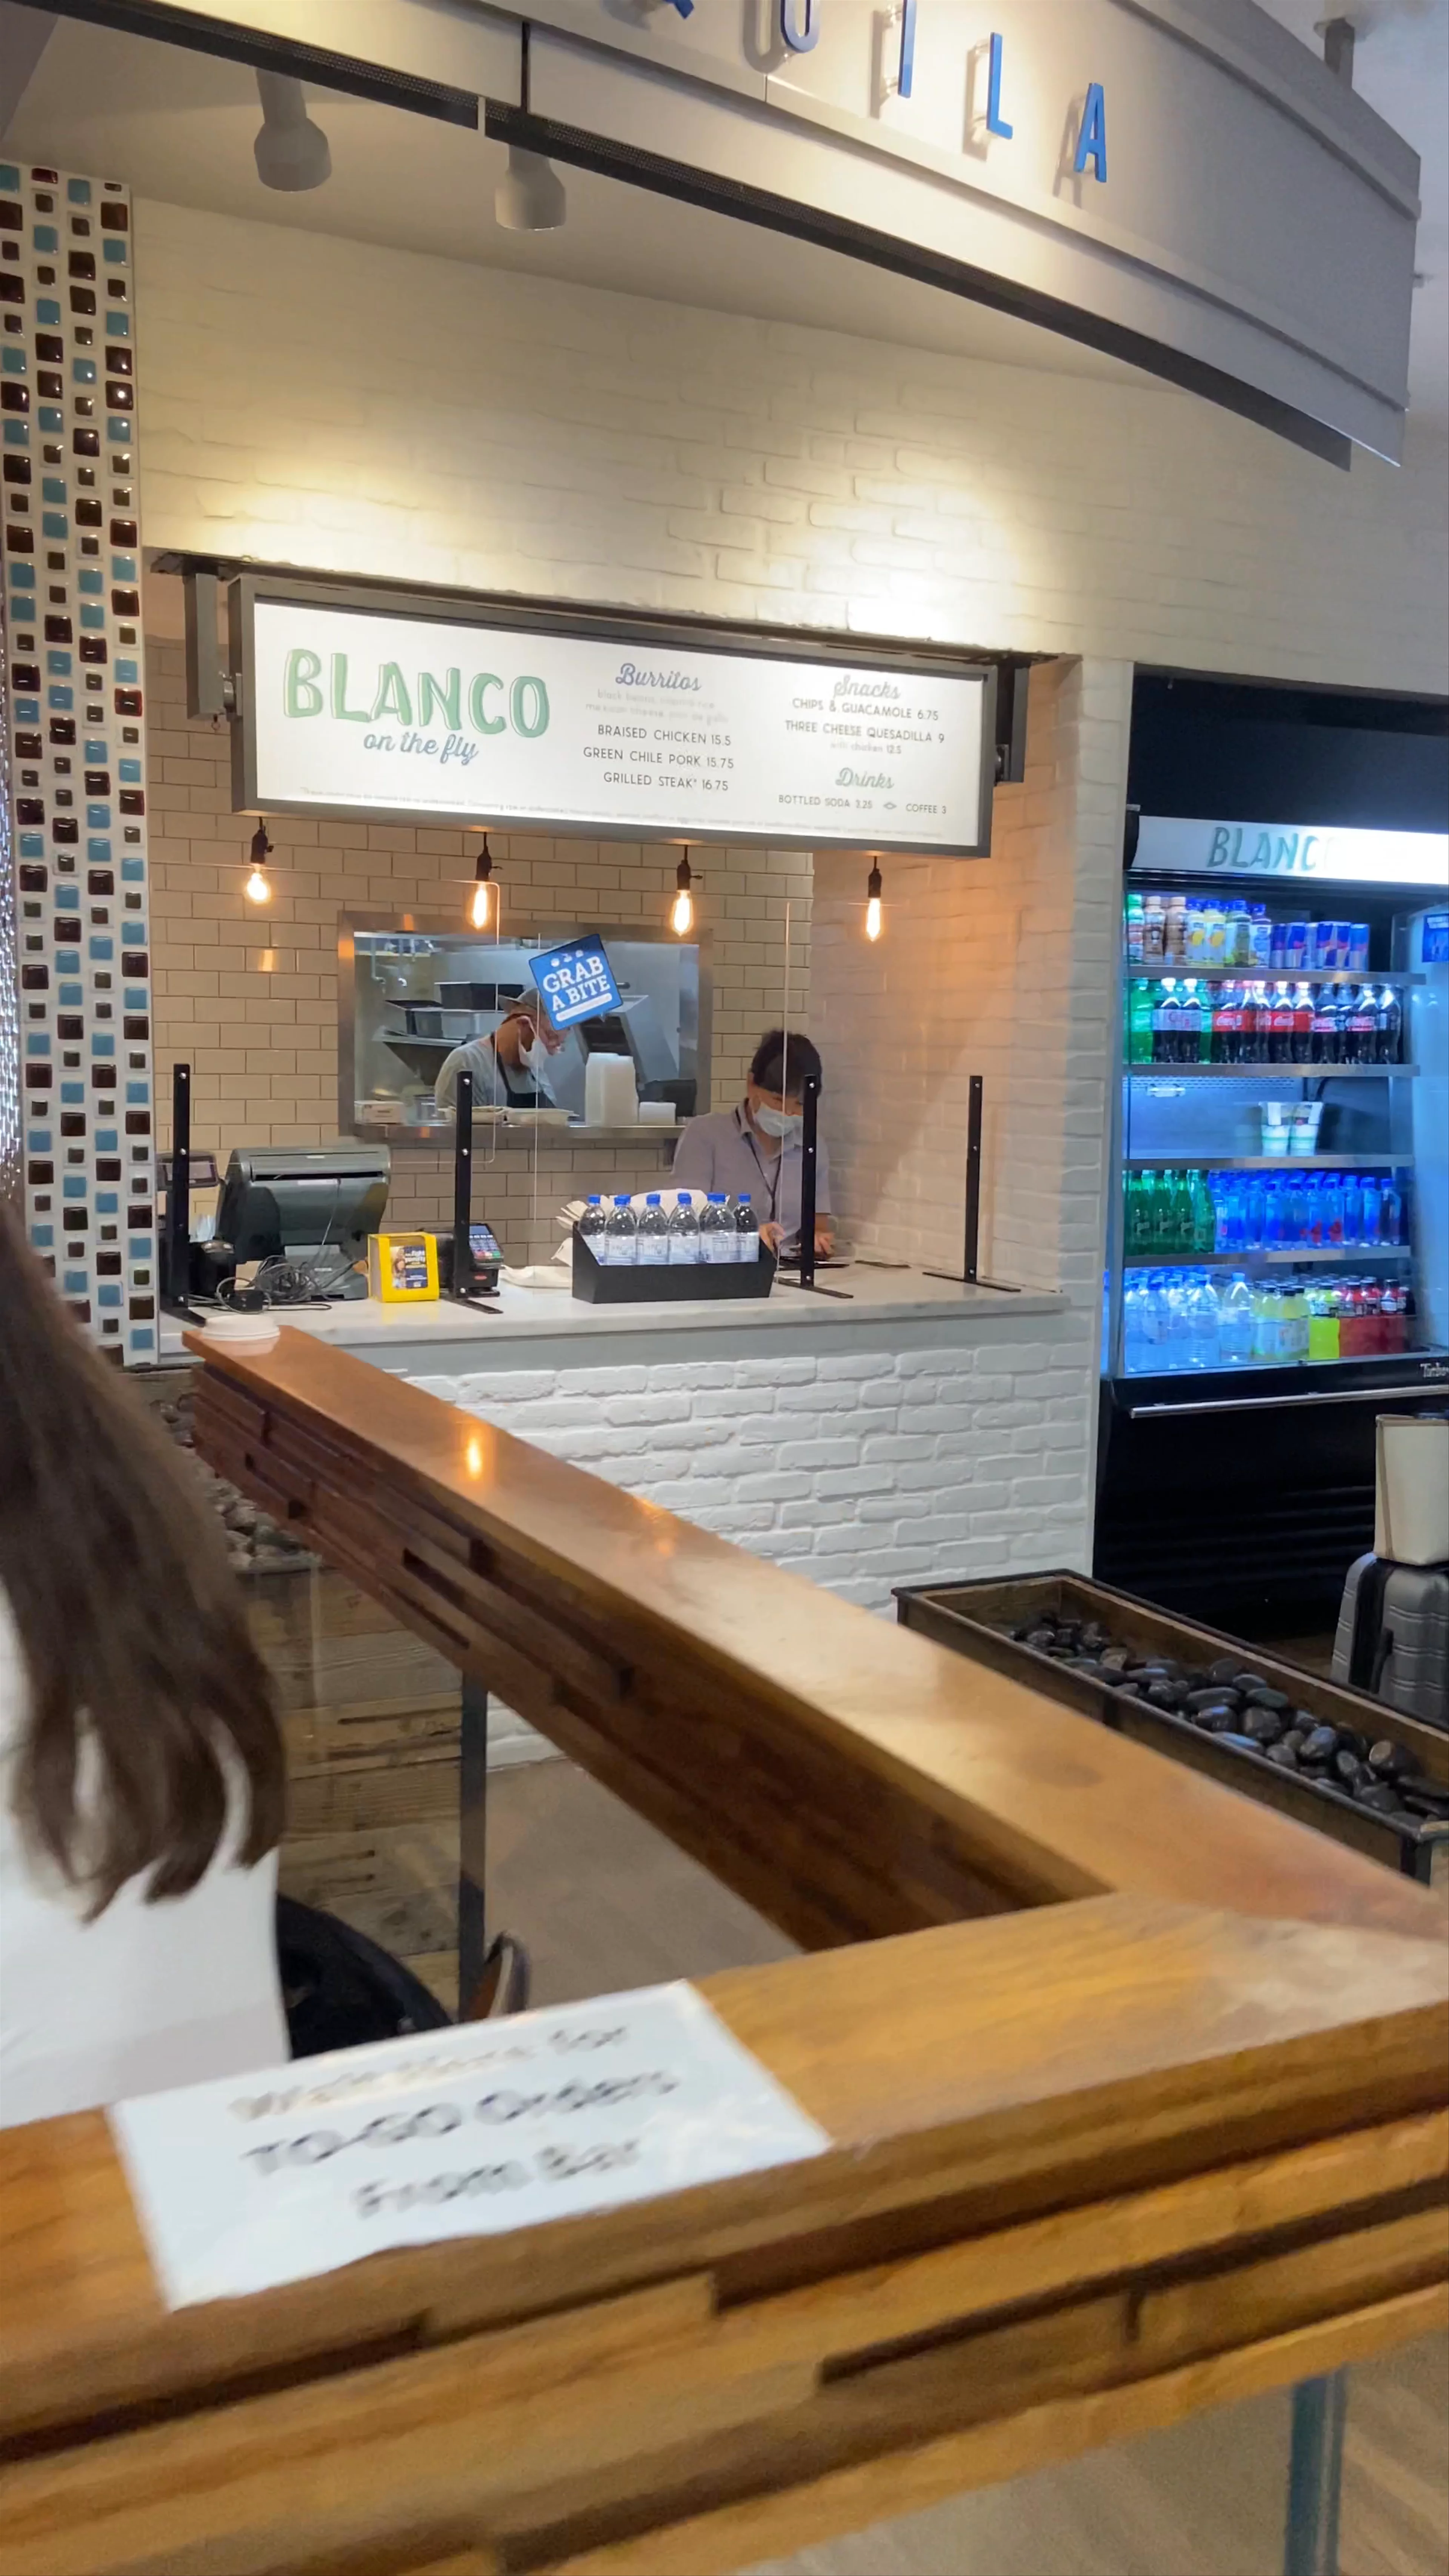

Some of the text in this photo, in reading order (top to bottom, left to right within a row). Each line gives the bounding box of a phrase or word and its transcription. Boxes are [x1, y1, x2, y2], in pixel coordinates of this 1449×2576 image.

[660, 0, 1107, 182] ILA
[615, 663, 702, 691] Burritos
[833, 674, 901, 700] Snacks
[283, 649, 550, 738] BLANCO
[792, 697, 824, 711] CHIPS
[829, 700, 837, 712] &
[841, 702, 912, 719] GUACAMOLE
[598, 724, 731, 746] BRAISED CHICKEN 15.5
[785, 720, 945, 744] THREE CHEESE QUESADILLA 9
[363, 731, 480, 765] on the fly
[583, 746, 623, 760] GREEN
[629, 751, 663, 764] CHILE
[669, 754, 701, 767] PORK
[603, 772, 652, 786] GRILLED
[835, 767, 895, 789] Drinks
[778, 794, 821, 806] BOTTLED
[824, 797, 850, 808] SODA
[905, 803, 938, 814] COFFEE
[941, 806, 947, 815] 3
[1206, 826, 1340, 871] BLANC
[543, 956, 604, 993] GRAB
[552, 994, 566, 1012] A
[565, 974, 611, 1005] BITE
[240, 2066, 681, 2177] TO-GO Orders
